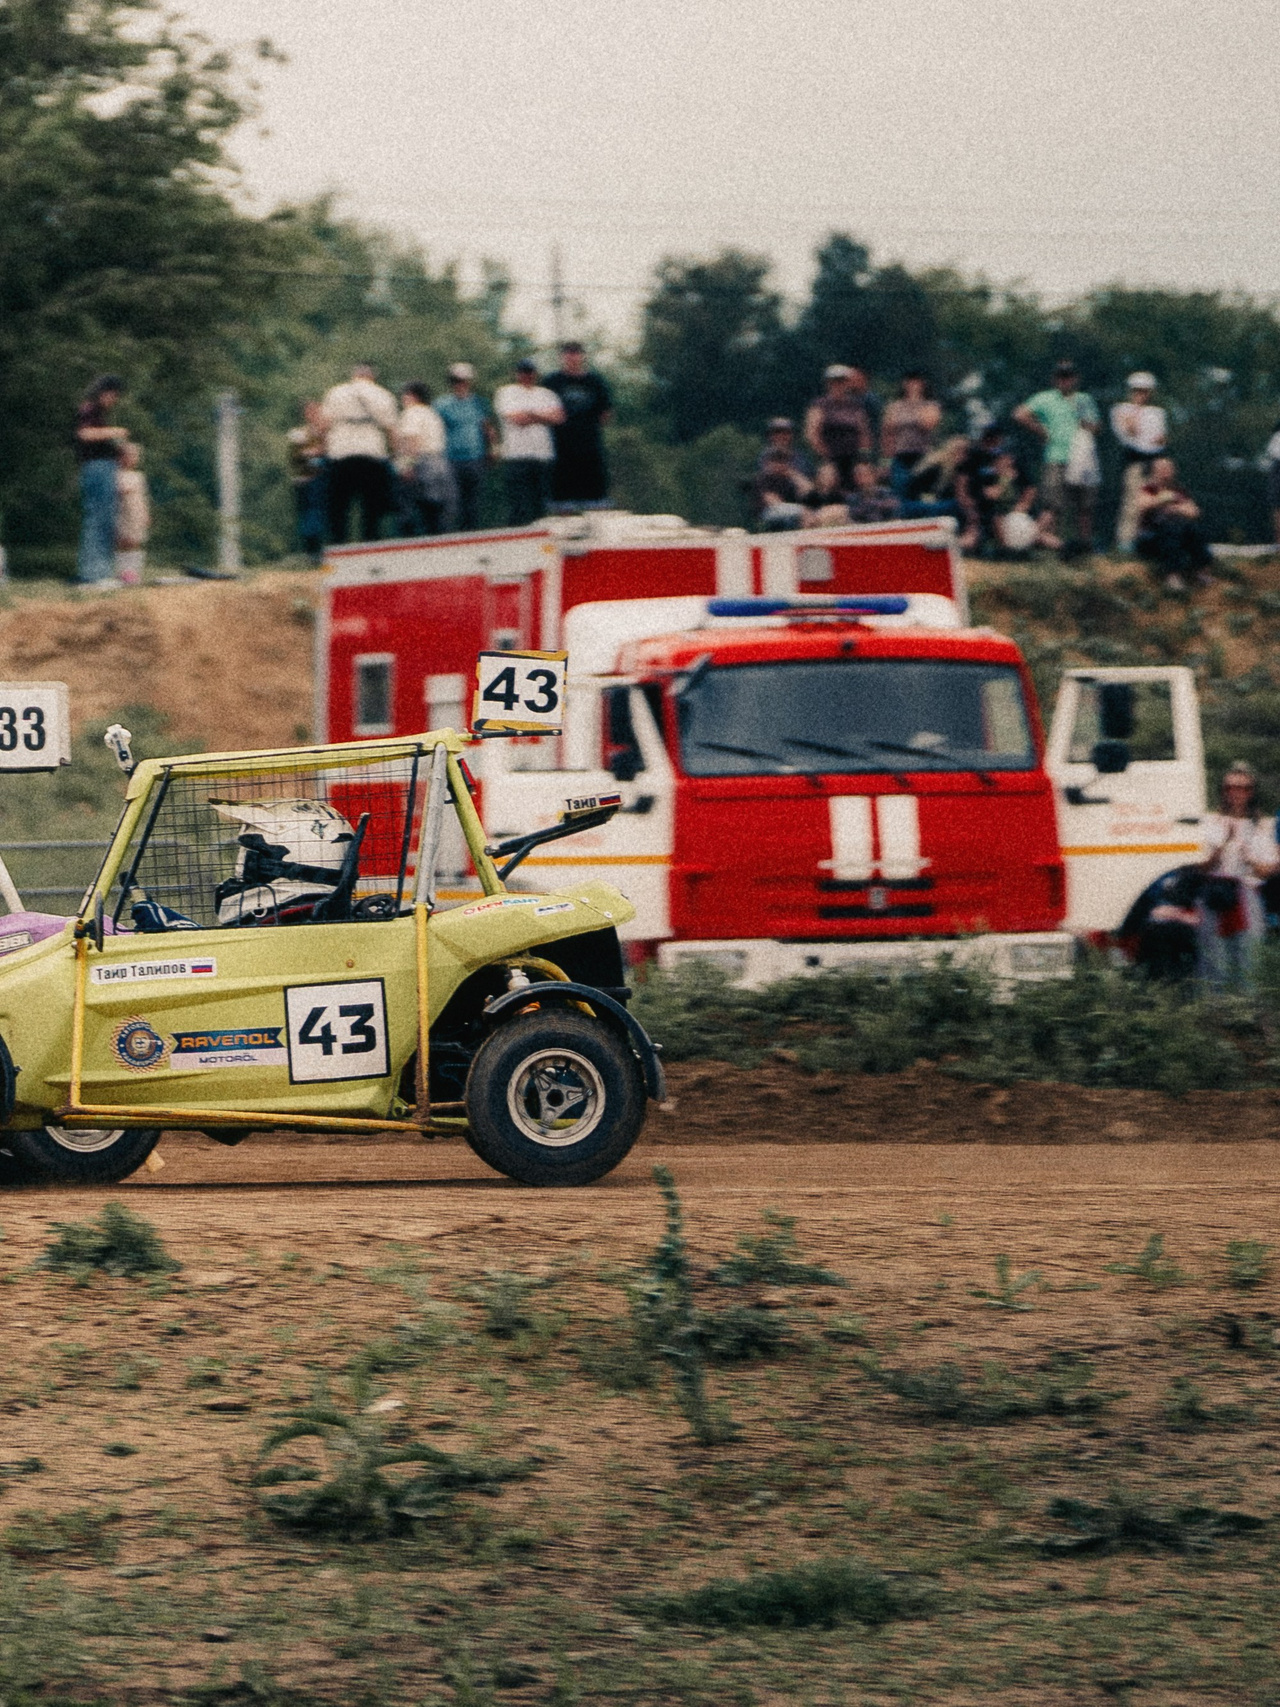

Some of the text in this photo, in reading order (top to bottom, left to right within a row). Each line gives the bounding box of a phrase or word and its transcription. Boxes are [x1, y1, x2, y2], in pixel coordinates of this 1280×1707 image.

[482, 666, 559, 713] 43
[565, 797, 597, 811] Таир
[96, 964, 187, 980] Таир Талипов
[297, 1002, 377, 1056] 43
[181, 1033, 275, 1048] RAVENOL
